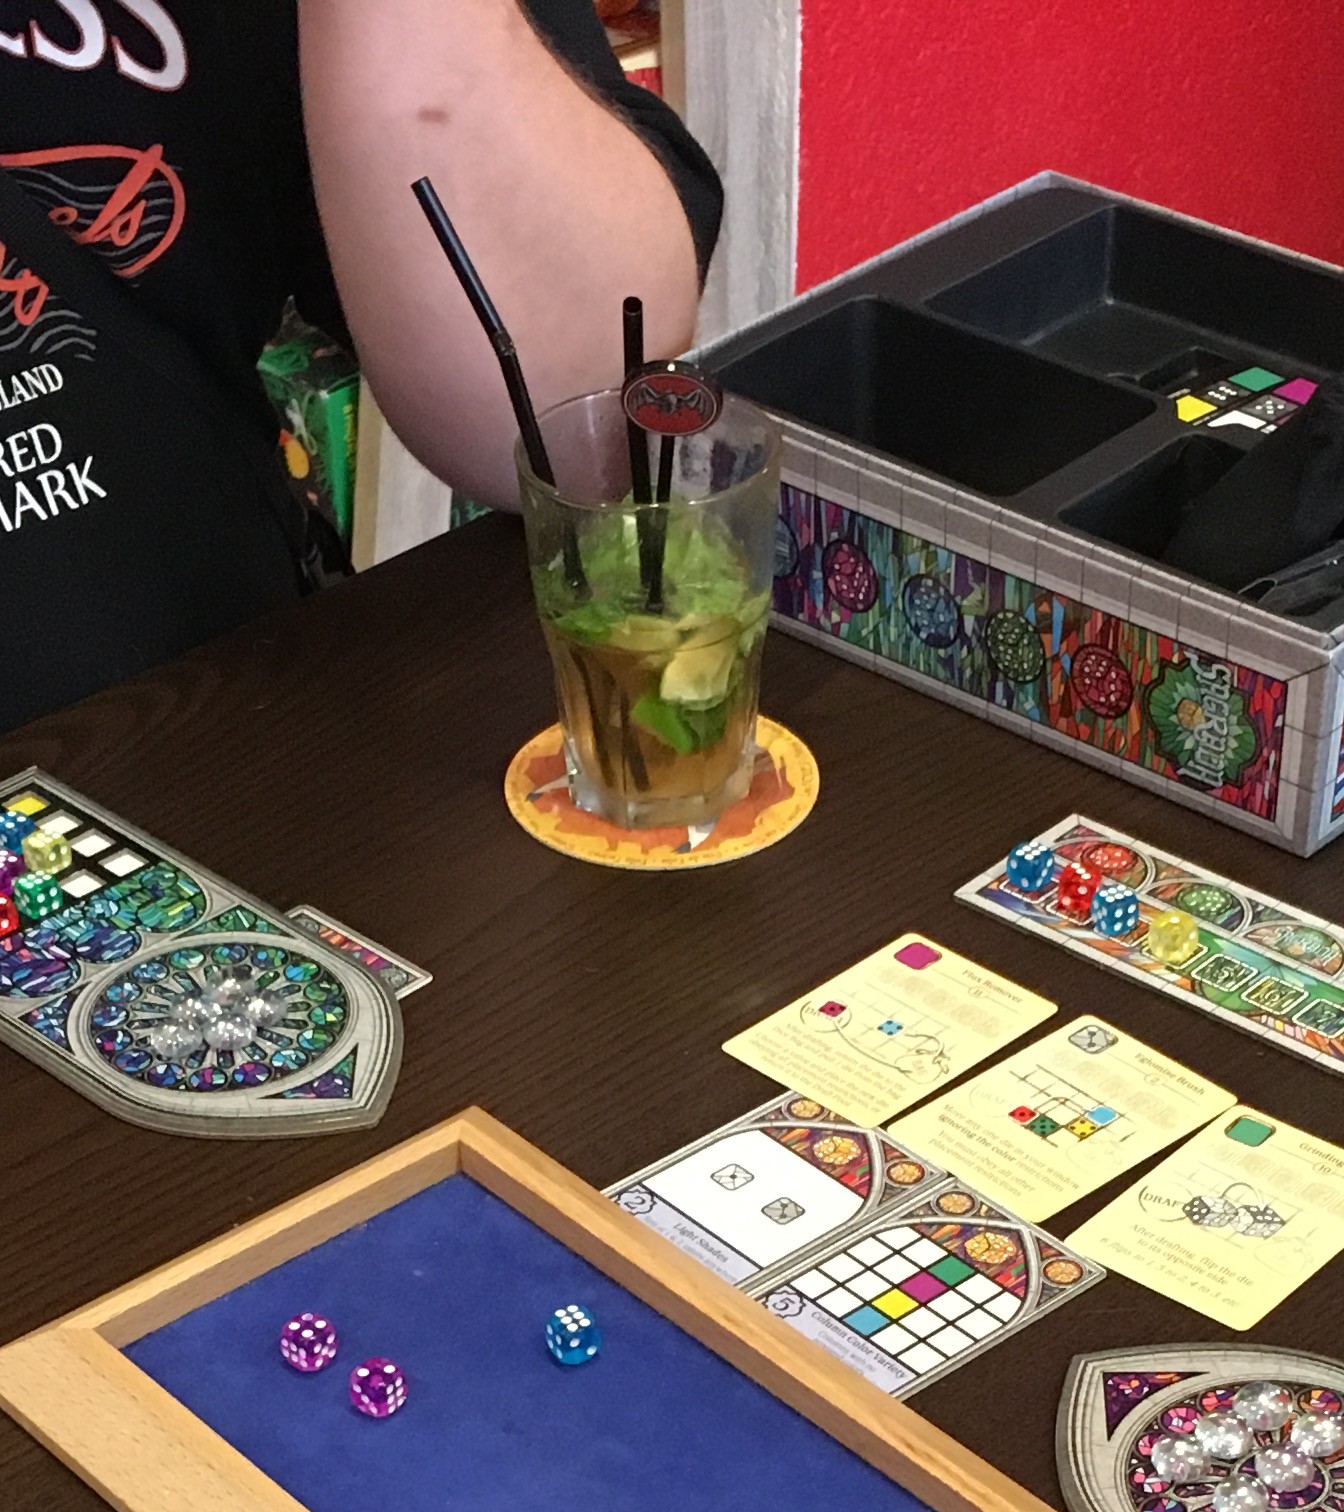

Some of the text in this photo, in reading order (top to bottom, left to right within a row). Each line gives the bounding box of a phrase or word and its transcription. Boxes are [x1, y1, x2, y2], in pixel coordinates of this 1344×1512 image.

[1177, 651, 1232, 788] SAGRADA
[1175, 1077, 1207, 1094] Brush
[623, 1195, 648, 1209] 2
[1142, 1190, 1182, 1209] DRAF
[671, 1222, 731, 1262] Light Shades
[770, 1296, 797, 1311] 5
[809, 1310, 850, 1337] Column
[845, 1335, 875, 1355] Color
[868, 1353, 908, 1379] Variety
